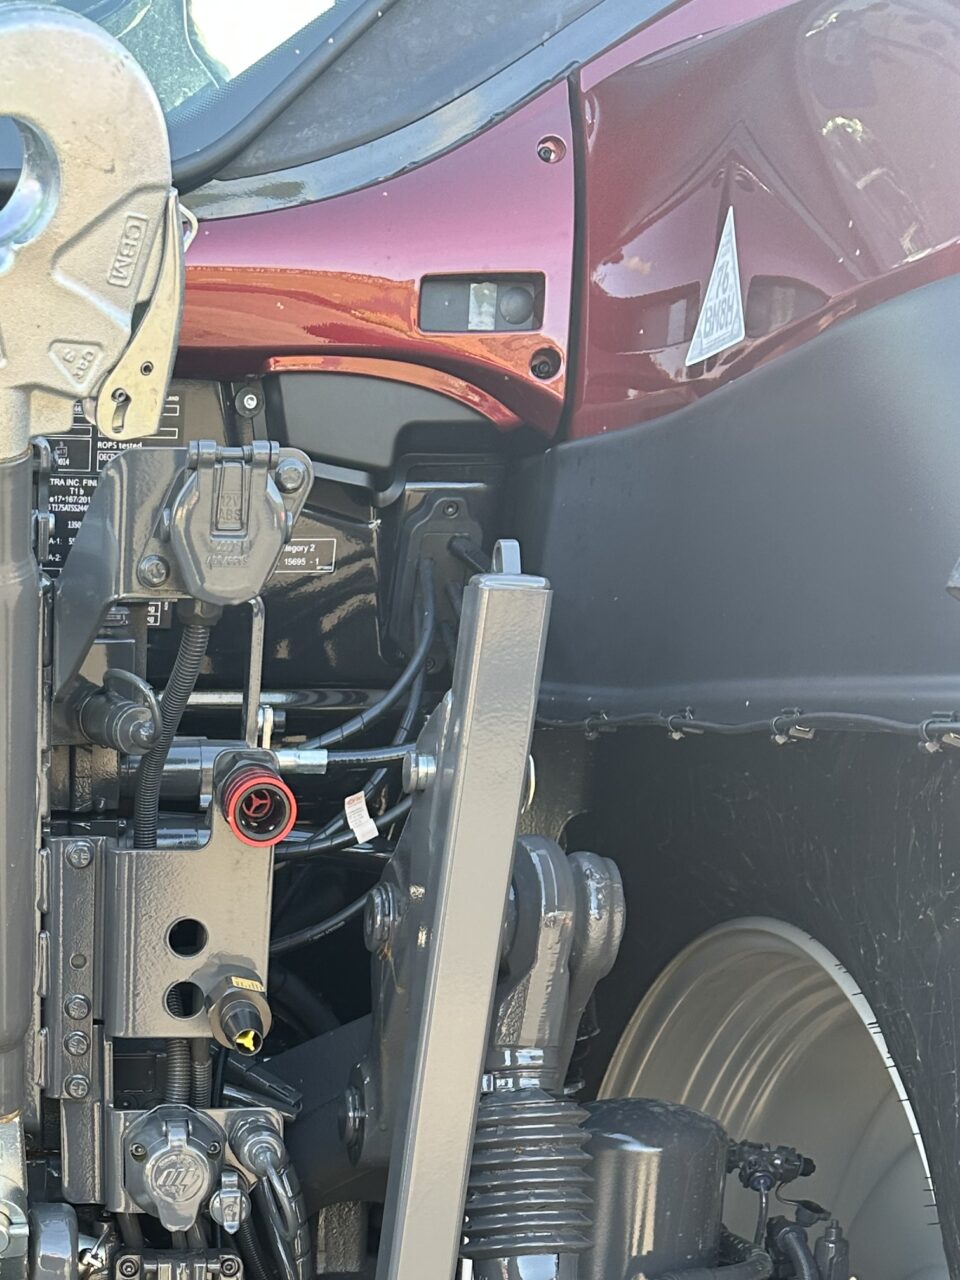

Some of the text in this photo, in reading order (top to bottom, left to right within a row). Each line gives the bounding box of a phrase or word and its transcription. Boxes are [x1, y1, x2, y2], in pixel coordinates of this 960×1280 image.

[112, 225, 142, 280] CBM
[715, 261, 730, 299] 76
[704, 293, 734, 337] BM8H
[97, 441, 117, 449] ROPS
[49, 478, 65, 487] TRA
[221, 496, 241, 508] 12V
[220, 508, 242, 521] ABS
